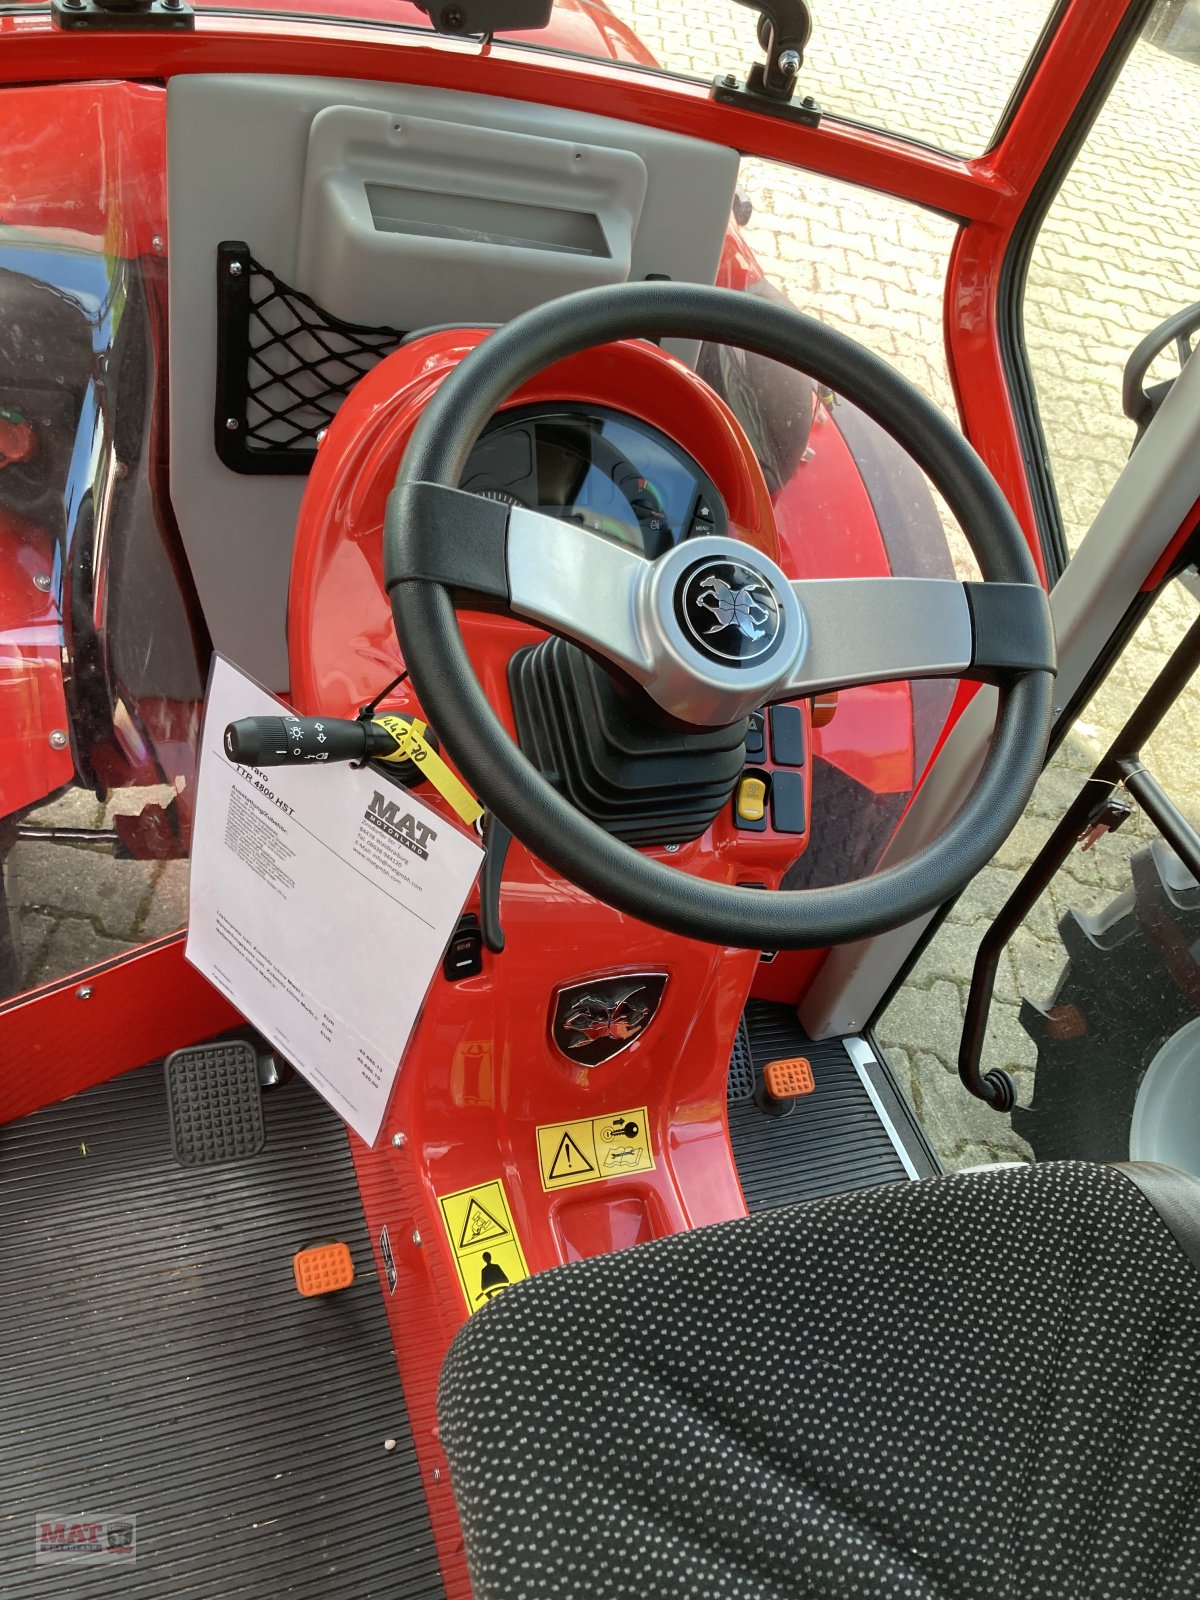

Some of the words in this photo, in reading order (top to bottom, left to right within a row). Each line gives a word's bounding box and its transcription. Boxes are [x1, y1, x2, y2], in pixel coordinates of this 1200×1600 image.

[235, 764, 252, 782] TTR
[254, 781, 275, 800] 4800
[275, 797, 296, 815] HST
[367, 789, 438, 850] MAT
[367, 813, 425, 856] MOTORLAND
[352, 847, 402, 885] www.matgmbh.com
[372, 853, 423, 891] info@matgmbh.com
